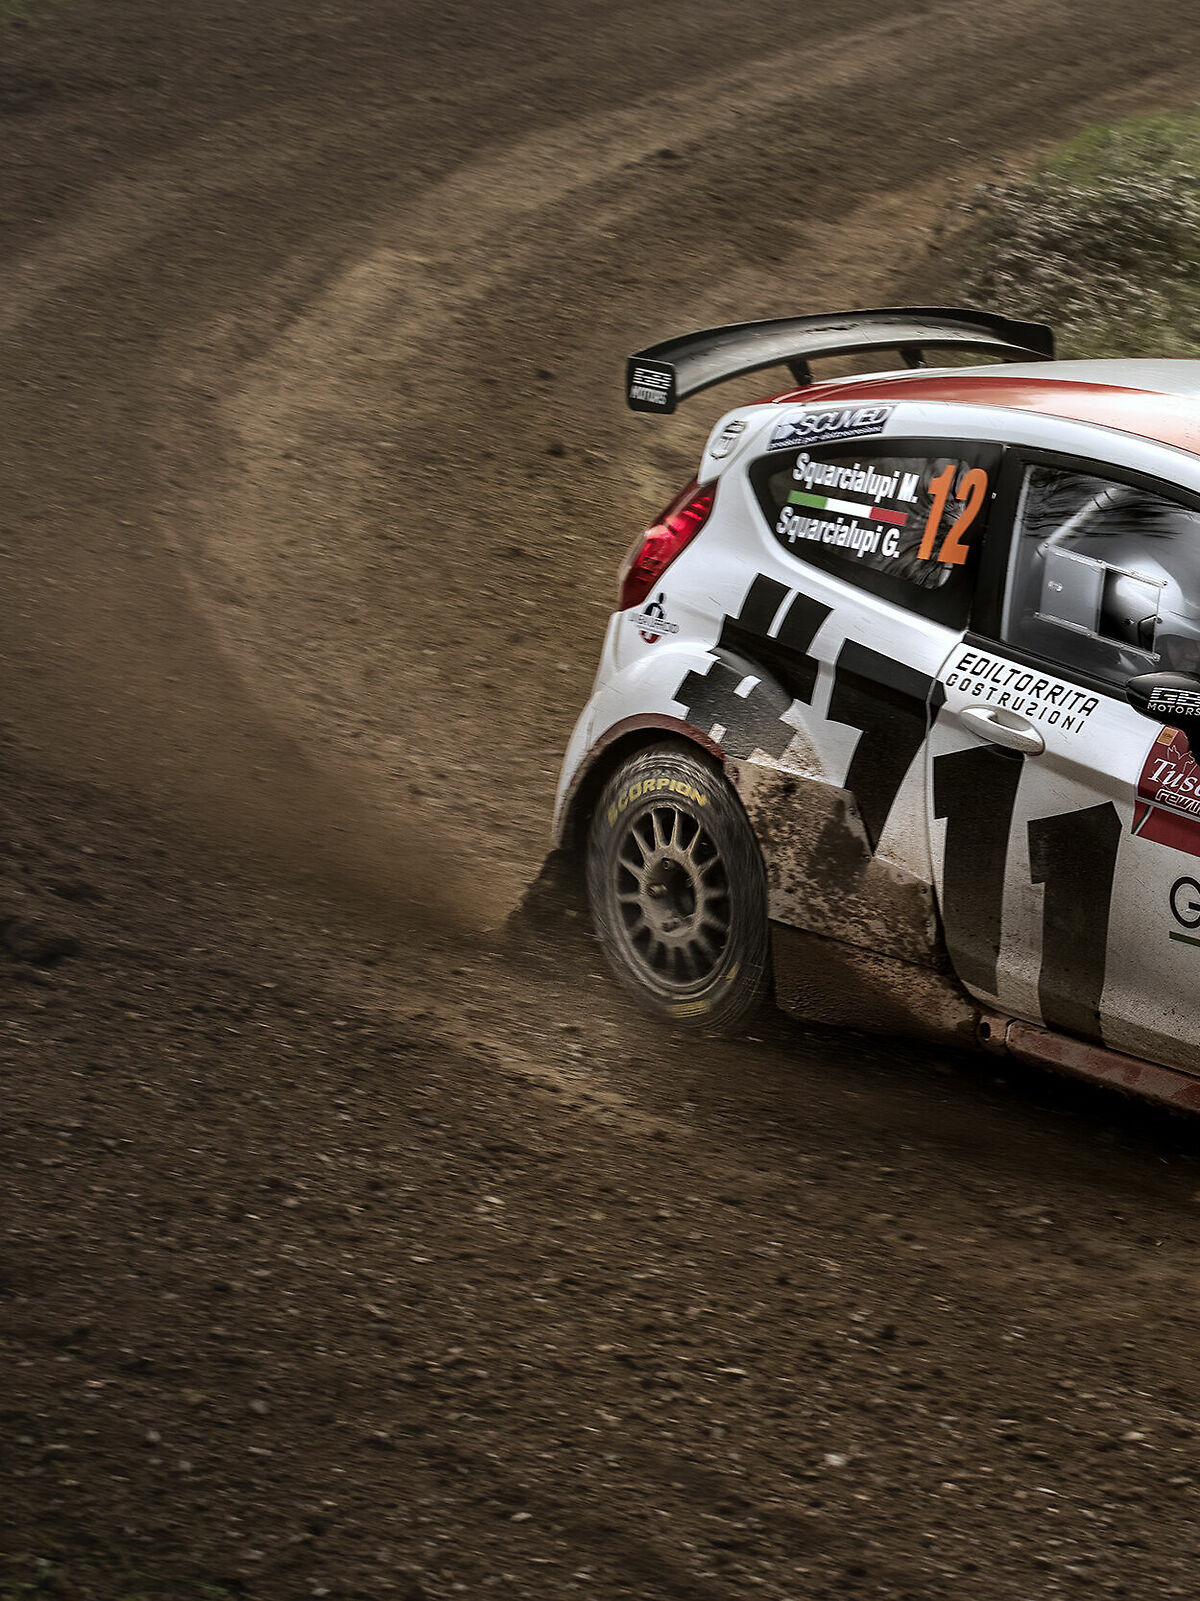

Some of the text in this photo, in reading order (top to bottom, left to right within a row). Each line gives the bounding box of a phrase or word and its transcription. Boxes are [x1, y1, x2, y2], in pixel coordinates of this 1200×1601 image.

[793, 452, 920, 504] Squarcialupi M.
[776, 506, 900, 559] Squarcialupi G.
[917, 464, 989, 565] 12
[945, 673, 1086, 735] COSTRUZIONI
[955, 652, 1099, 718] EDILTORRITA
[607, 777, 708, 829] SCORPION
